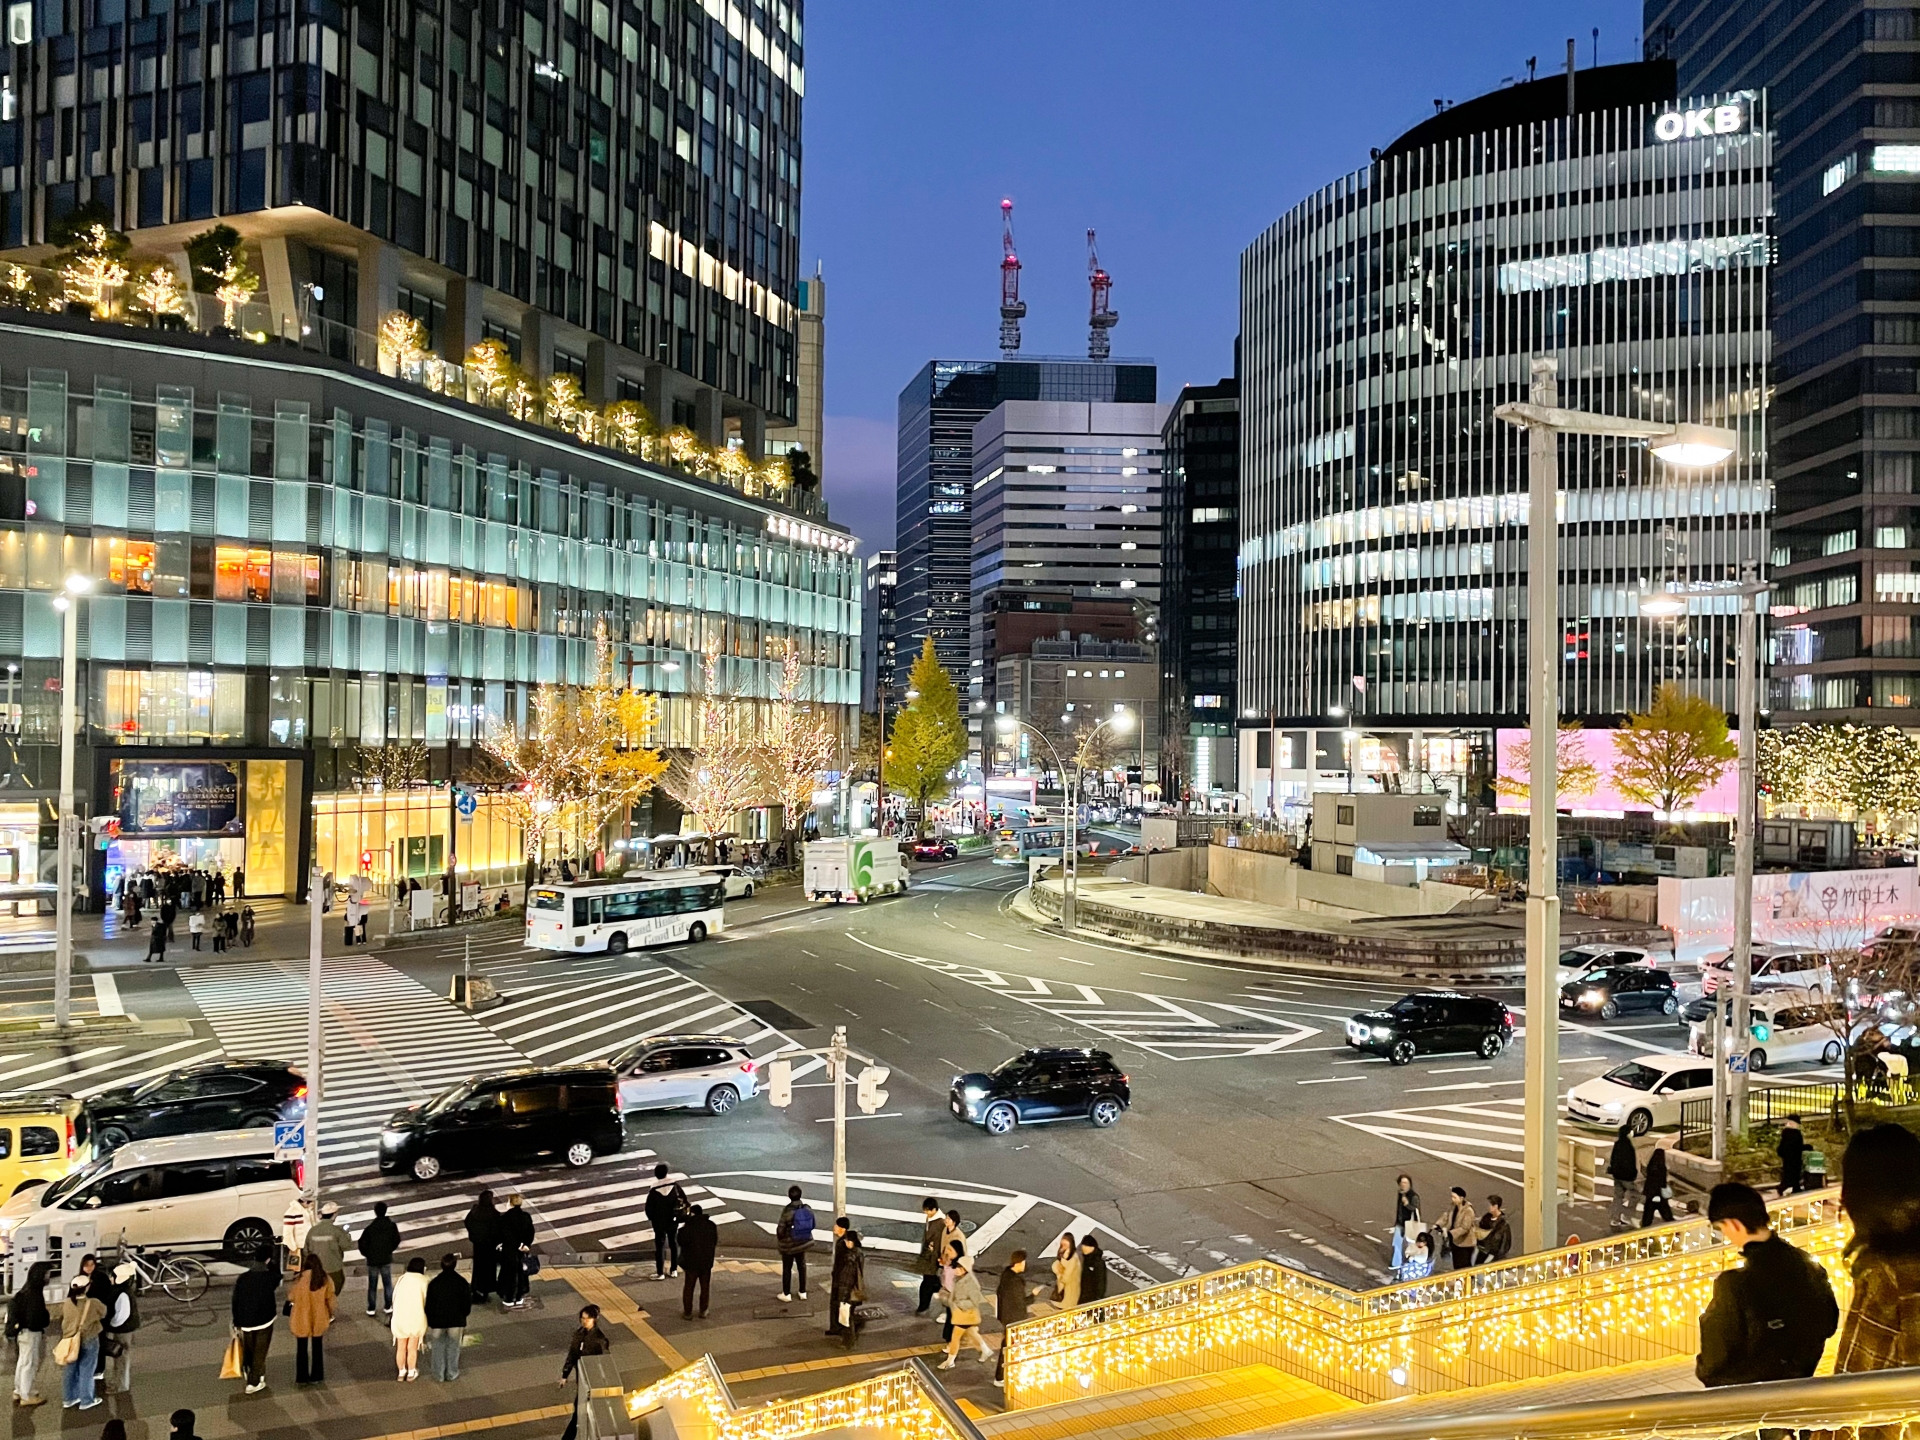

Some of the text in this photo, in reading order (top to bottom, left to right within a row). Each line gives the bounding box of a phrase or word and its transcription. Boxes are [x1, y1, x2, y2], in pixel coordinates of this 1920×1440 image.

[1655, 106, 1740, 140] OKB
[1842, 885, 1899, 909] 竹中土木
[626, 920, 652, 938] Good
[644, 922, 690, 946] Good Life
